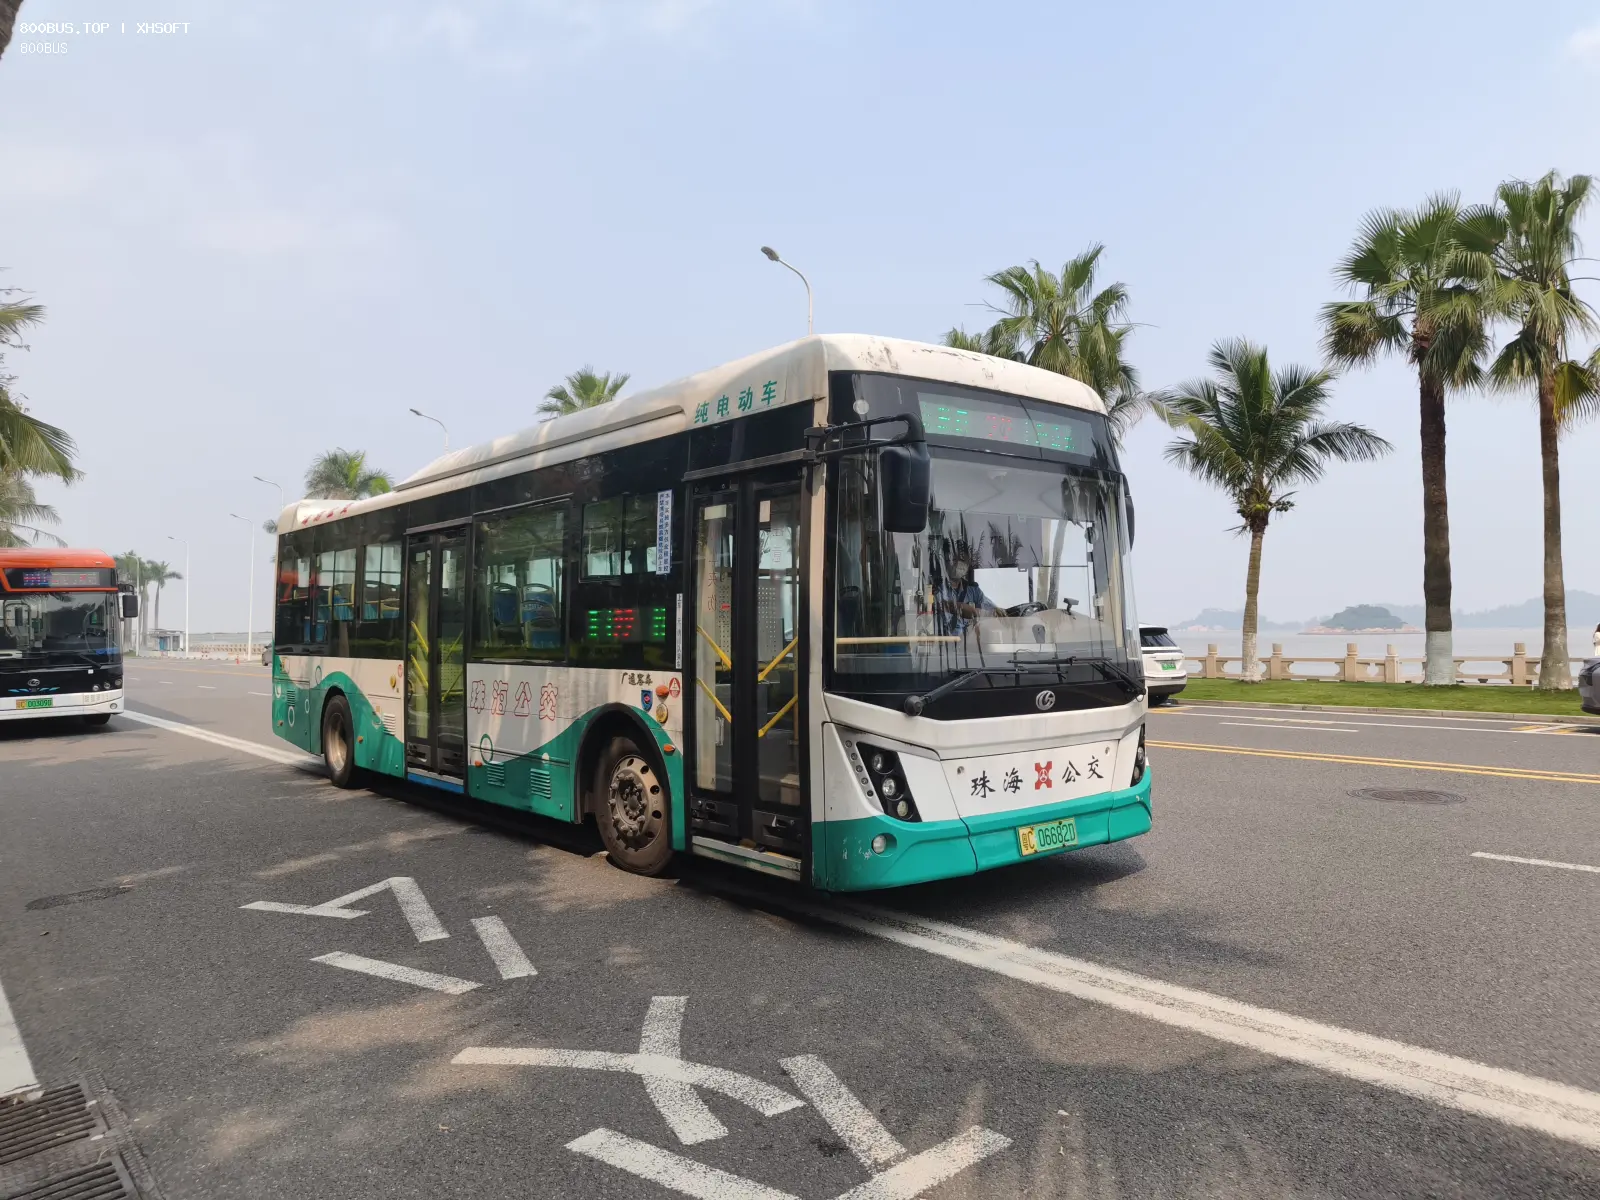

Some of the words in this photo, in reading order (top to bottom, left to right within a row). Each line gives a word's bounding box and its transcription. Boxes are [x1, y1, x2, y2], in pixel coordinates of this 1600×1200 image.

[694, 380, 778, 424] 纯电动车
[469, 679, 559, 722] 珠海公交
